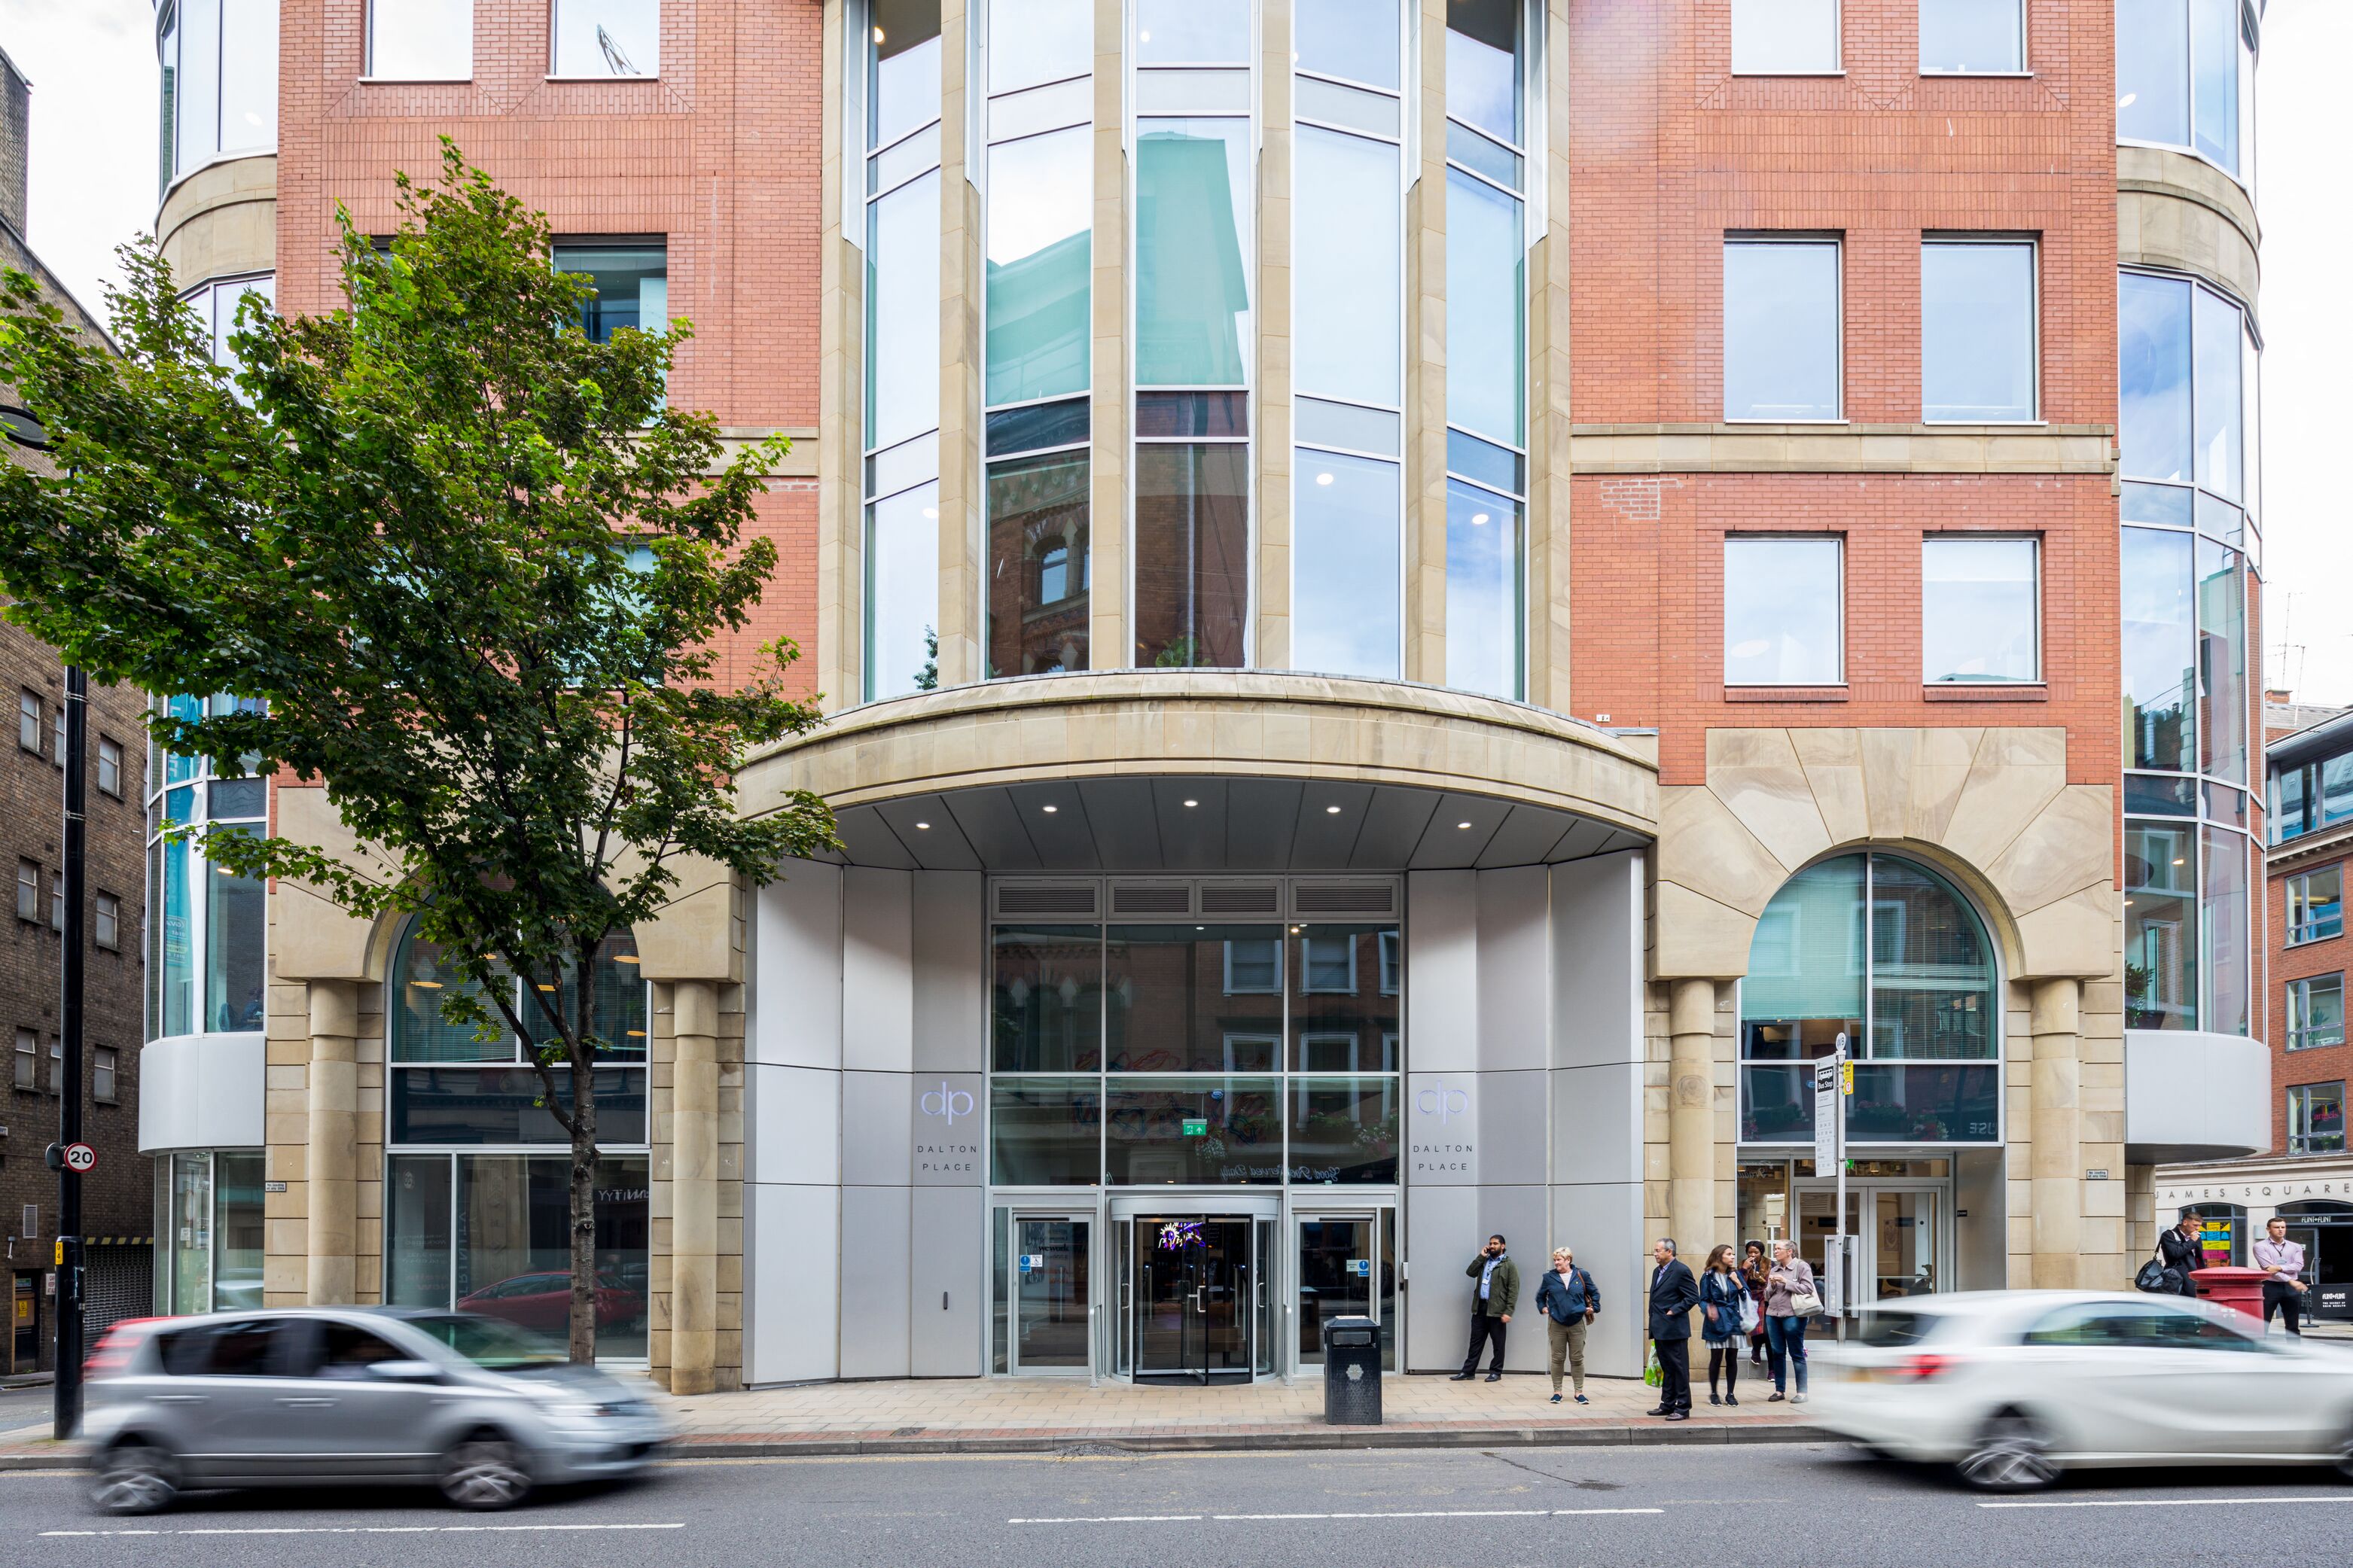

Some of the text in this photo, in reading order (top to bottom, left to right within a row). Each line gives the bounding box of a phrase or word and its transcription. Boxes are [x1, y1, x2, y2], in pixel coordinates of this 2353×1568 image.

[70, 1151, 93, 1164] 20
[922, 1163, 971, 1171] PLACE
[2245, 1183, 2350, 1196] SQUARE
[1038, 1244, 1070, 1252] wework
